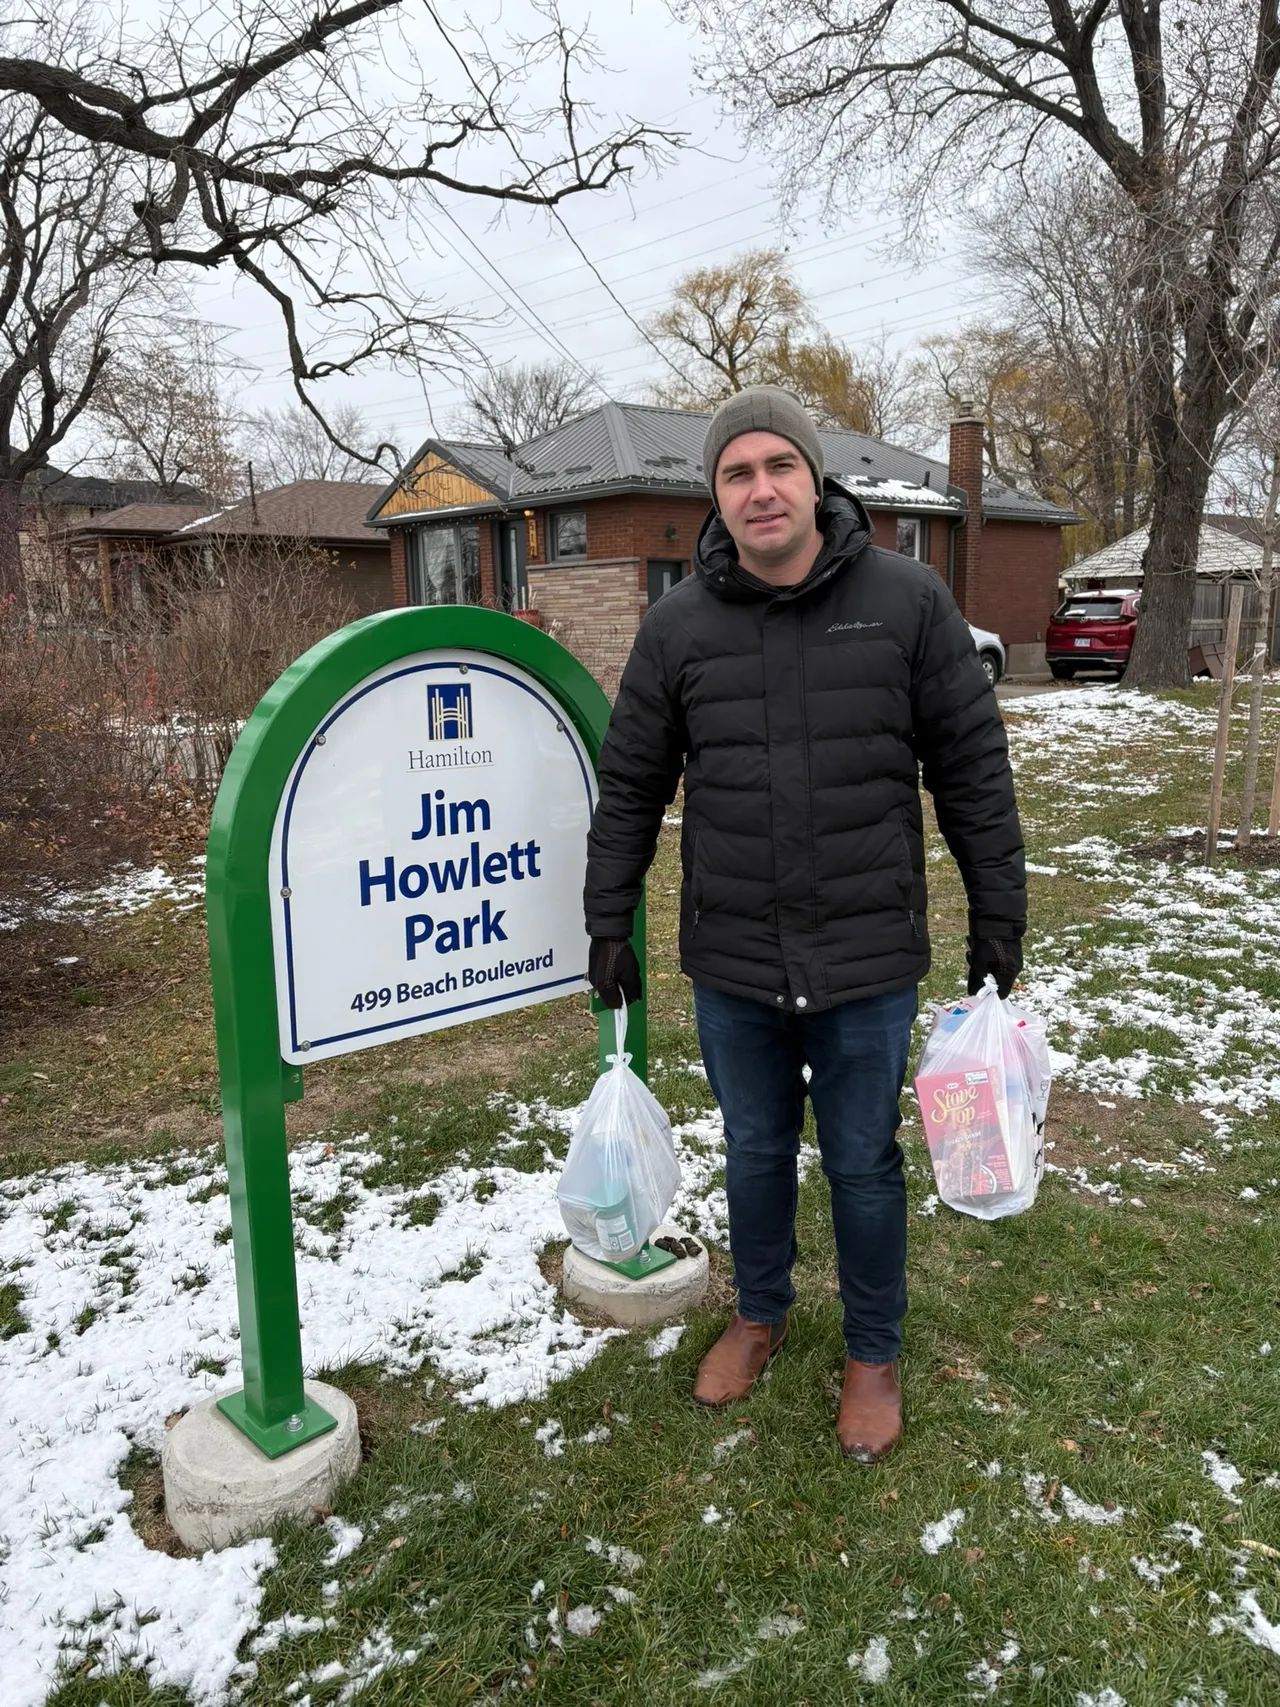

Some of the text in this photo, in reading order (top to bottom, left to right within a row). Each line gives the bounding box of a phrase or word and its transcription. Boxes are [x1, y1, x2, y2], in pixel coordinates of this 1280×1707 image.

[408, 745, 493, 769] Hamilton
[411, 789, 491, 841] Jim
[359, 840, 541, 907] Howlett
[405, 900, 508, 961] Park
[350, 948, 554, 1013] 499 Beach Boulevard
[931, 1086, 979, 1123] Stove
[949, 1106, 976, 1130] Top
